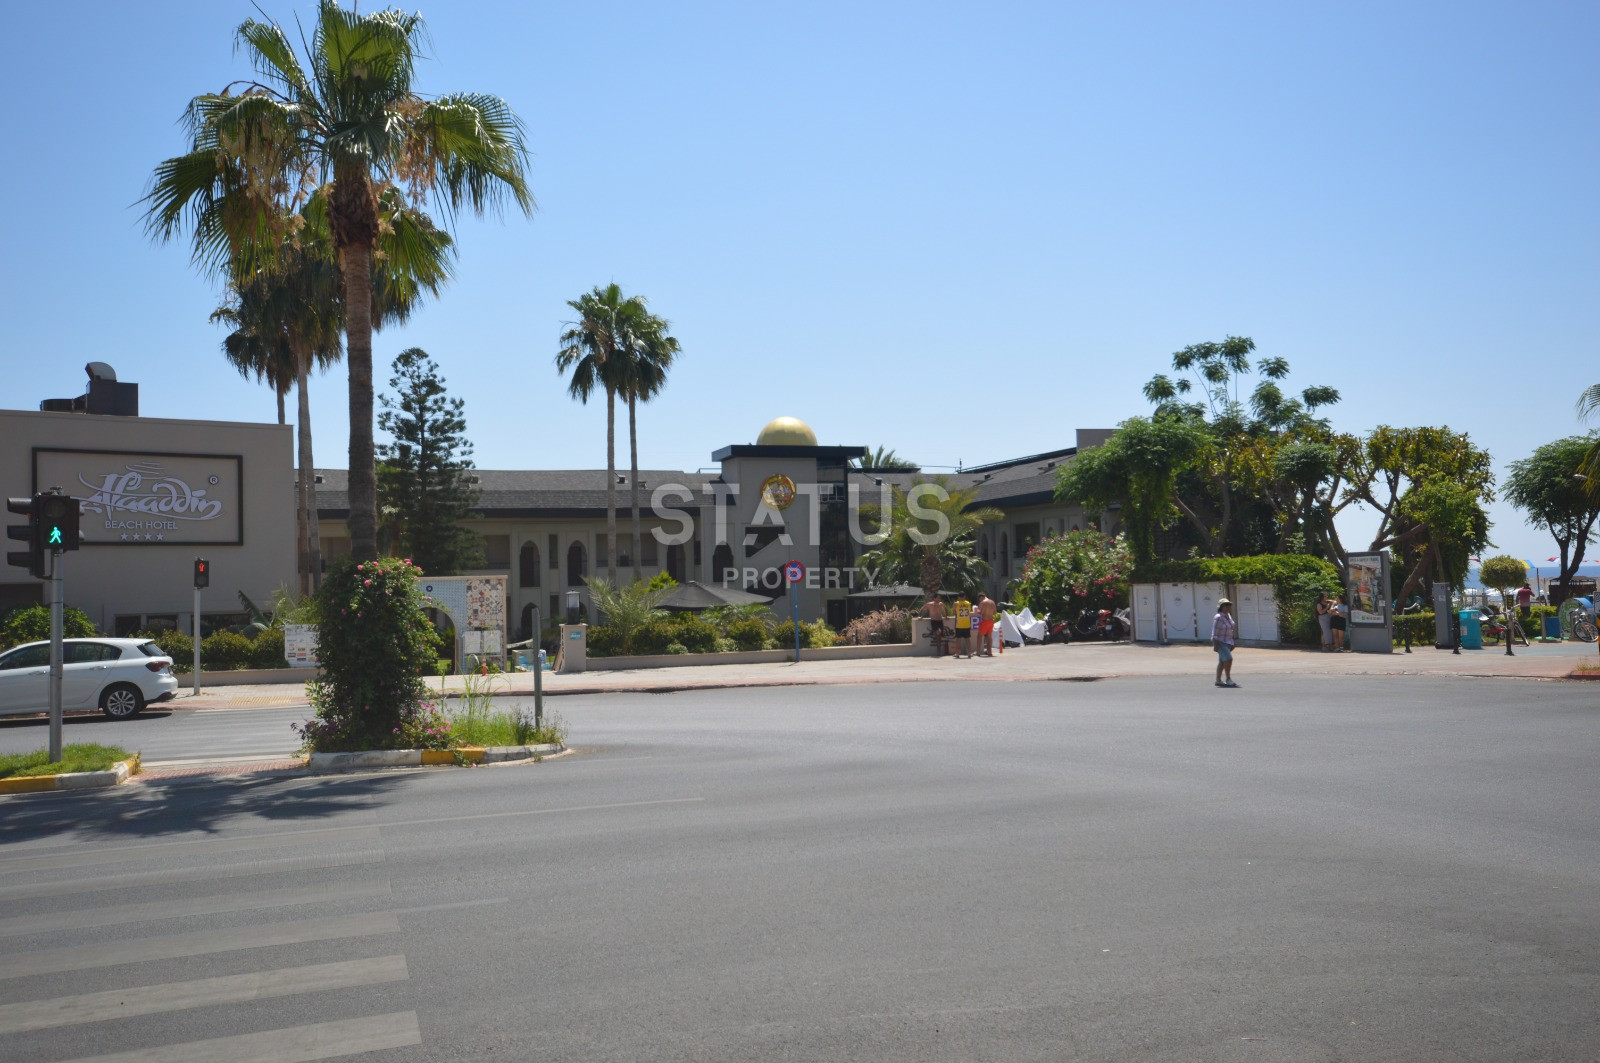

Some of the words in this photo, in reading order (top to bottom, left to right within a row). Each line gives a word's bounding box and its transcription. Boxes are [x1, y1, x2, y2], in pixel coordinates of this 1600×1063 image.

[104, 520, 143, 529] BEACH
[145, 520, 179, 530] HOTEL
[959, 608, 970, 617] 23
